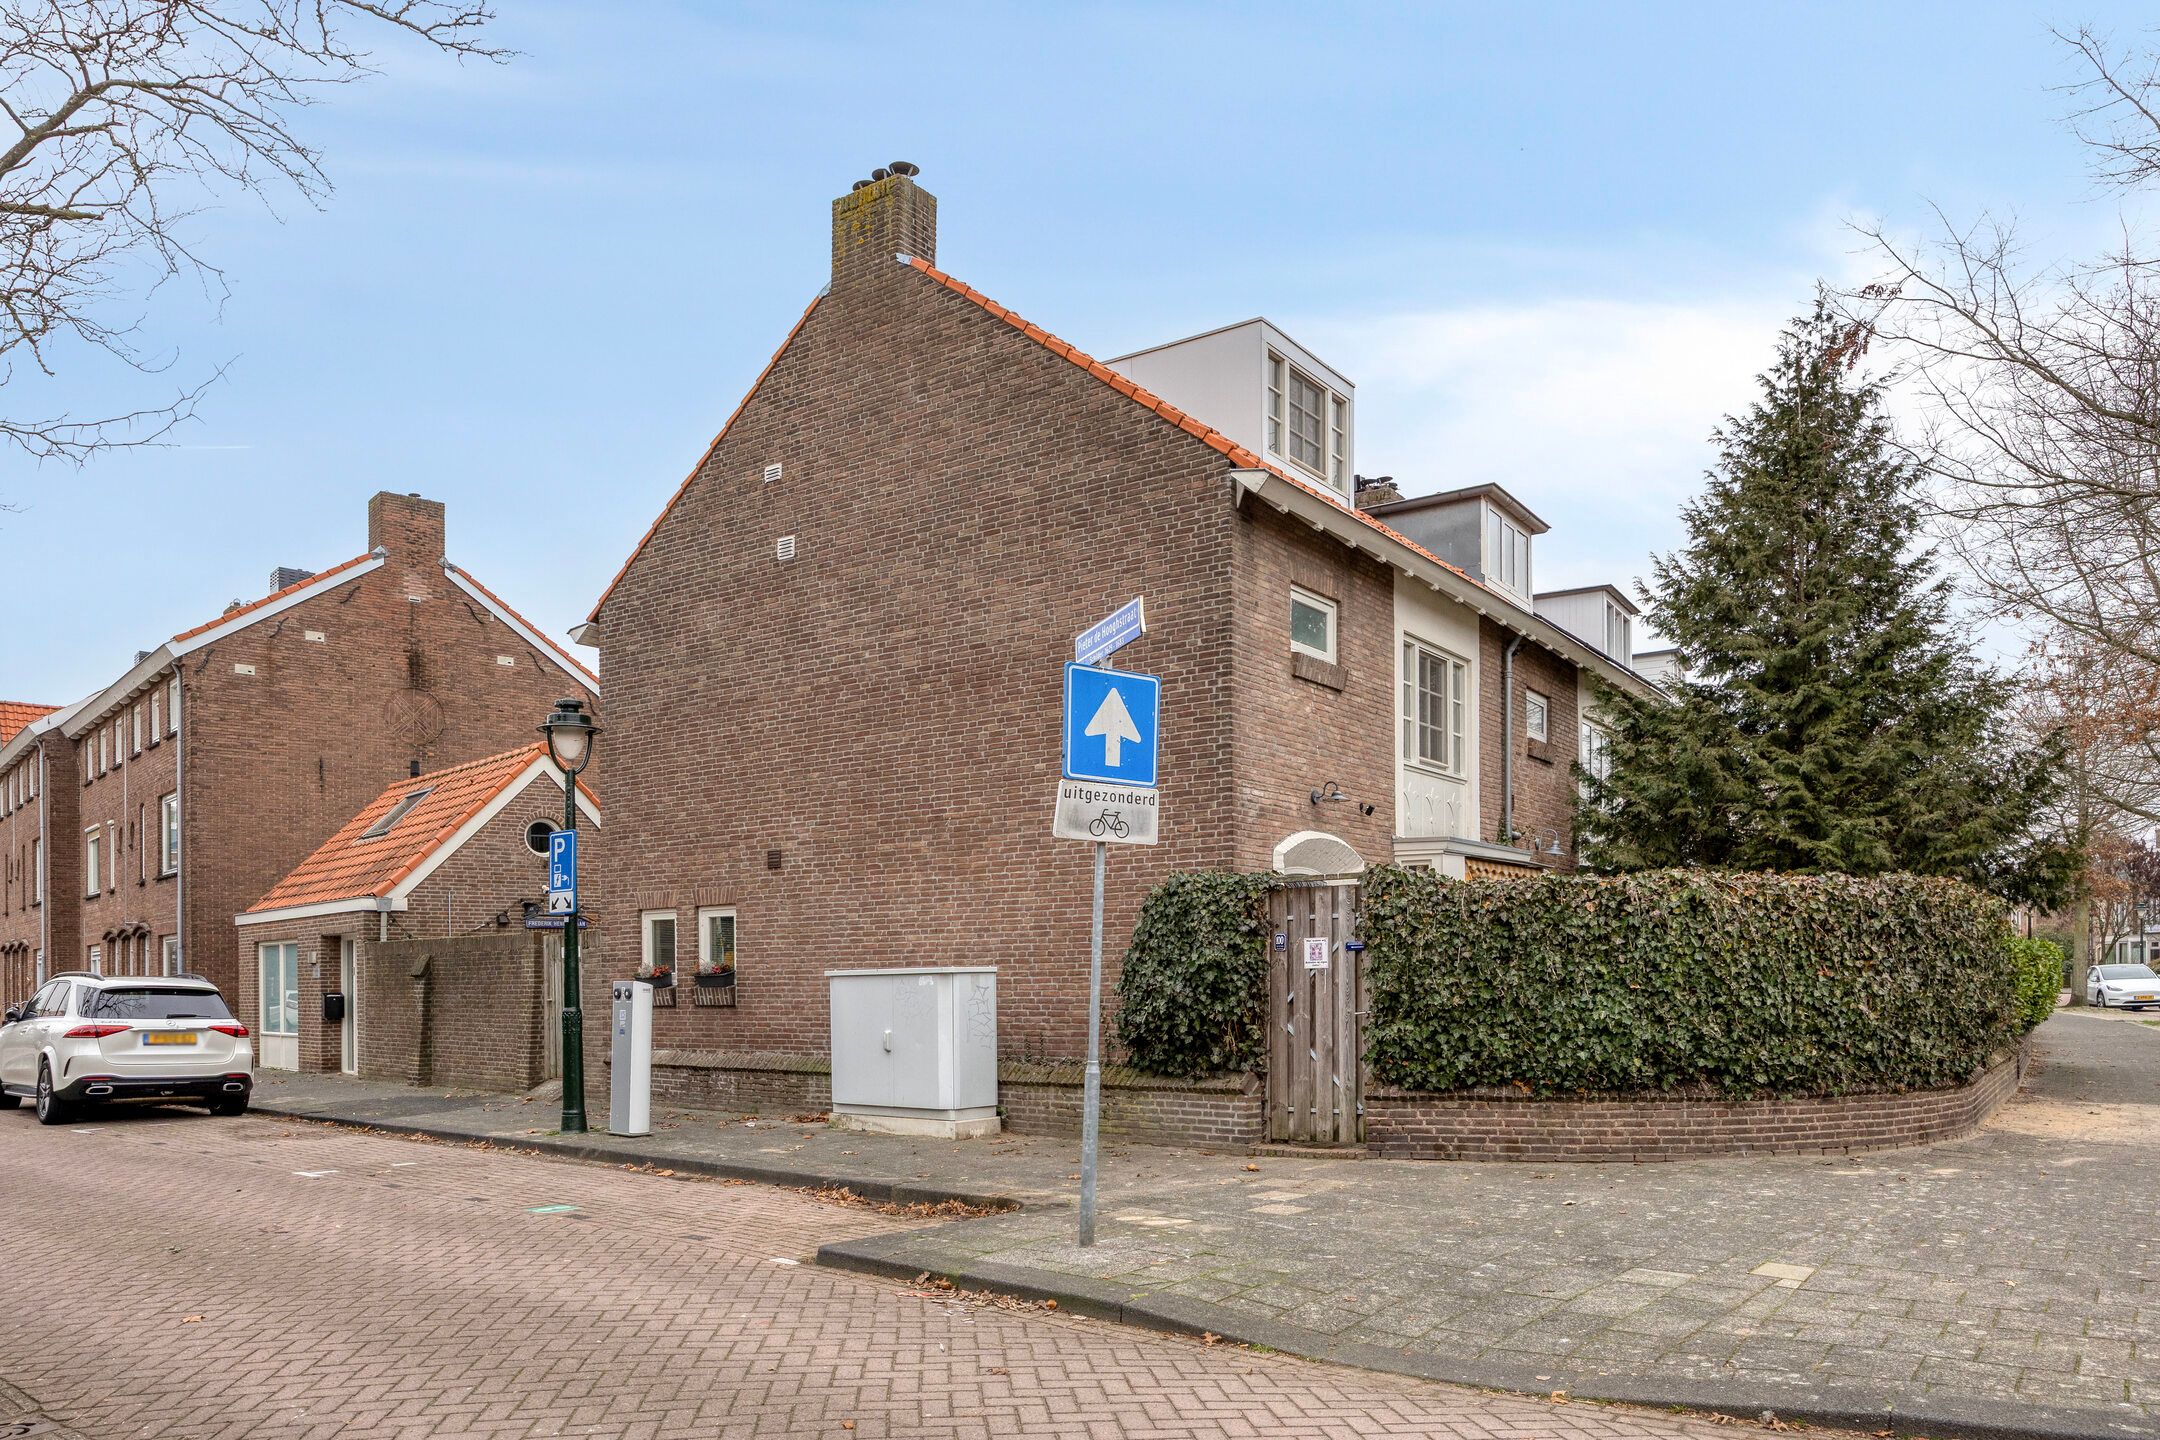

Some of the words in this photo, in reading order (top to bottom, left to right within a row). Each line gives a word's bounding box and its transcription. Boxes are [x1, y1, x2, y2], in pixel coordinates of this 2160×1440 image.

[1078, 636, 1093, 653] Pieter
[1094, 630, 1101, 642] de
[1102, 607, 1137, 638] Hooghstraat
[1064, 785, 1155, 806] uitgezonderd
[554, 838, 565, 862] P
